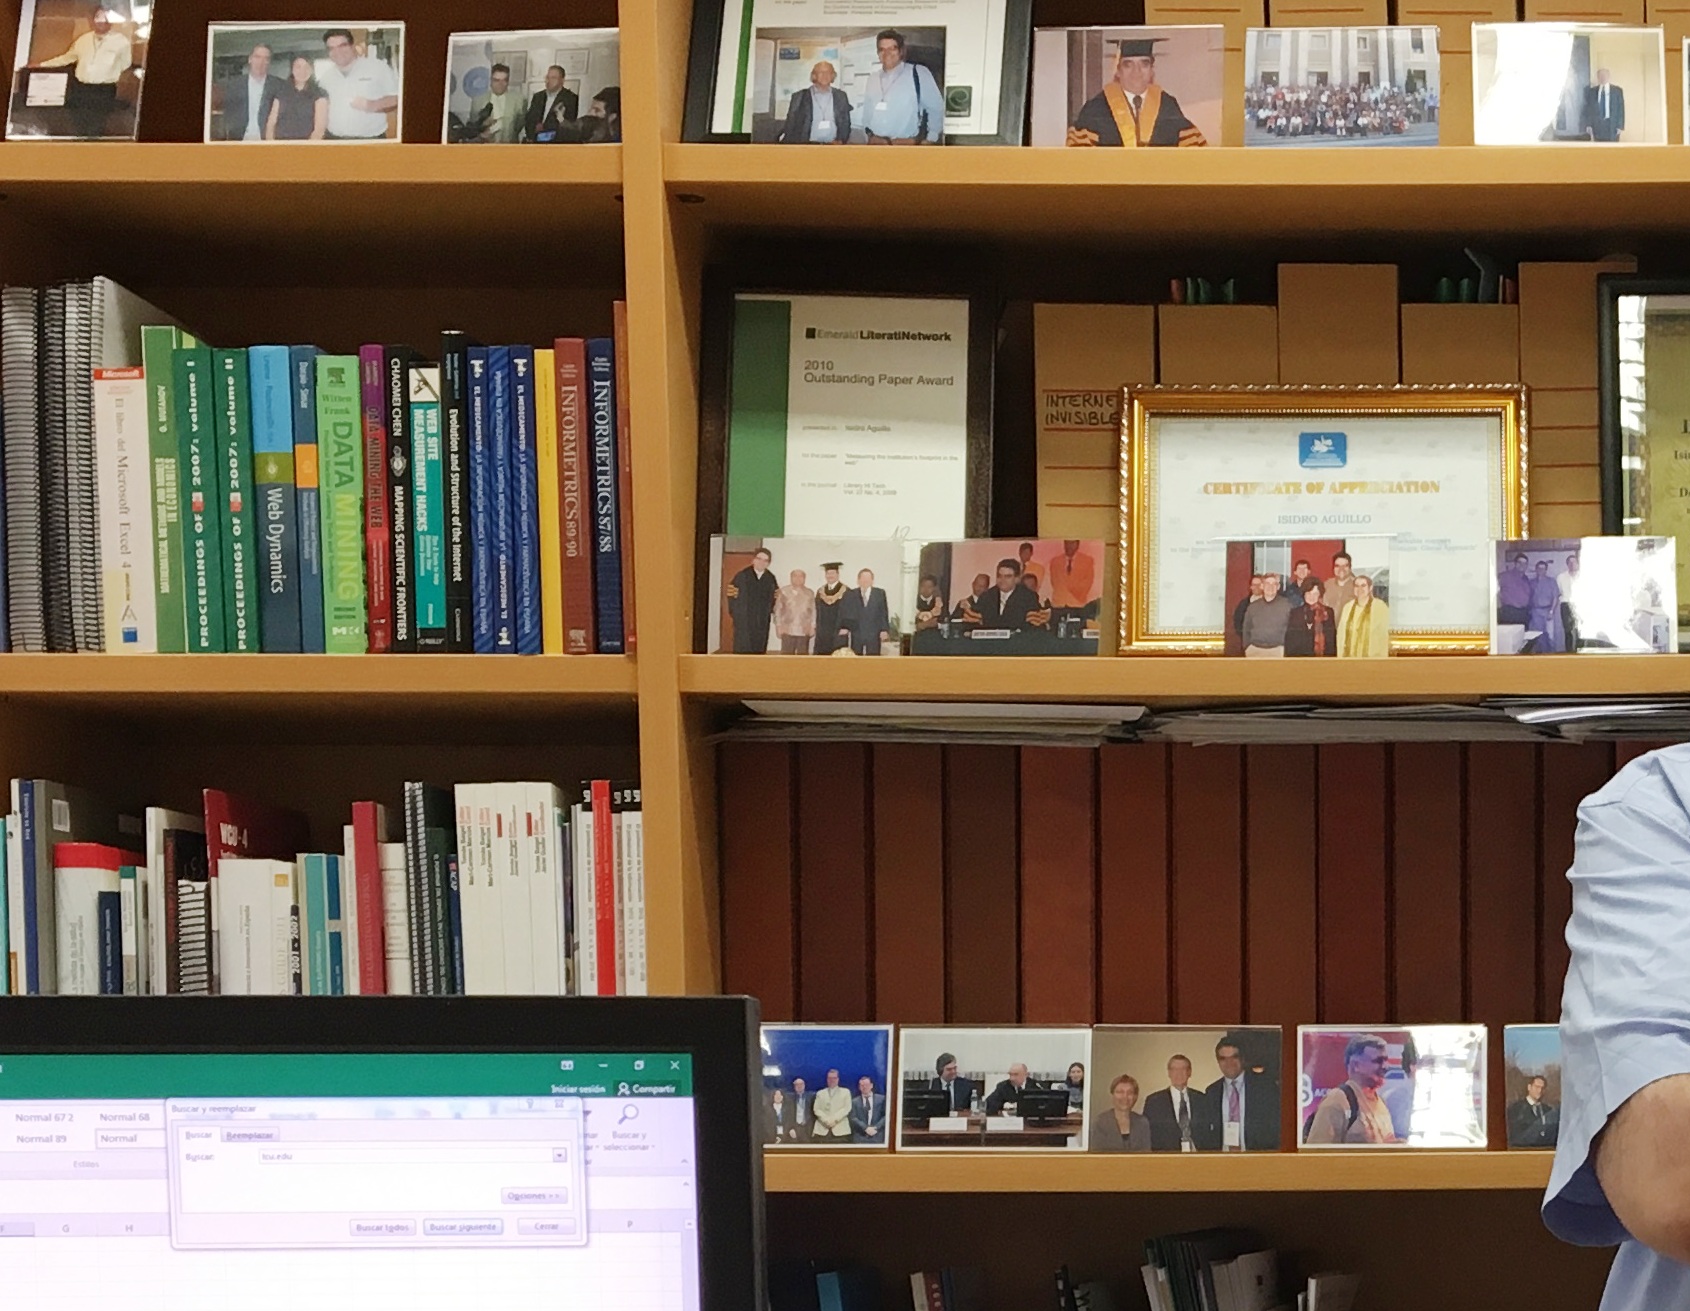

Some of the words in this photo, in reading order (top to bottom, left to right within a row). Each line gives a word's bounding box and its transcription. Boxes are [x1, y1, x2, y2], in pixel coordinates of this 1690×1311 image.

[102, 370, 140, 379] Microsoft
[224, 358, 234, 370] II
[804, 360, 834, 371] 2010
[390, 357, 402, 407] CHAOMEI
[804, 372, 875, 386] Outstanding
[878, 374, 914, 387] Paper
[916, 375, 954, 386] Award
[188, 372, 199, 432] volume
[226, 375, 237, 436] volume
[1045, 393, 1118, 408] INTERNE
[366, 406, 377, 432] DATA
[391, 408, 403, 437] CHEN
[426, 408, 438, 433] WEB
[1045, 409, 1120, 426] INVISIBLE
[449, 408, 460, 451] Evolution
[117, 438, 126, 453] del
[332, 421, 355, 488] DATA
[368, 436, 382, 478] MINING
[413, 408, 427, 492] MEASUREMENT
[427, 434, 439, 461] SITE
[561, 384, 579, 519] INFORMETRICS
[593, 379, 613, 515] INFORMETRICS
[190, 438, 202, 486] 2007:
[228, 441, 240, 489] 2007:
[450, 453, 460, 470] and
[117, 455, 131, 515] Microsoft
[165, 458, 177, 510] ECONOMICS
[370, 482, 382, 502] THE
[451, 472, 461, 514] Structure
[1202, 481, 1303, 495] CERTIFICATE
[1305, 481, 1325, 495] OF
[1328, 480, 1441, 494] APPRECIATION
[266, 487, 285, 521] Web
[393, 485, 406, 532] MAPPING
[416, 495, 428, 531] HACKS
[194, 513, 204, 533] OF
[232, 516, 242, 537] OF
[369, 505, 383, 528] WEB
[452, 516, 462, 526] of
[1277, 514, 1318, 525] ISIDRO
[1321, 514, 1372, 525] AGUILLO
[119, 522, 132, 555] Excel
[452, 527, 462, 542] the
[565, 520, 578, 557] 89/90
[598, 515, 613, 553] 87/88
[265, 523, 287, 594] Dynamics
[335, 493, 361, 603] MINING
[394, 532, 407, 586] SCIENTIFIC
[453, 544, 463, 582] Internet
[195, 539, 209, 647] PROCEEDINGS
[233, 542, 247, 650] PROCEEDINGS
[396, 586, 408, 641] FRONTIERS
[290, 915, 299, 940] 2002
[291, 951, 300, 974] 2001
[550, 1083, 577, 1095] Iniciar
[579, 1083, 606, 1095] sesión
[632, 1083, 677, 1096] Compartir
[15, 1113, 52, 1122] Normal
[54, 1113, 66, 1122] 67
[99, 1112, 137, 1122] Normal
[138, 1112, 151, 1122] 68
[171, 1104, 199, 1113] Buscar
[208, 1103, 257, 1114] reemplazar
[16, 1134, 53, 1143] Normal
[55, 1134, 67, 1143] 89
[100, 1133, 137, 1143] Normal
[185, 1130, 213, 1140] Buscar
[225, 1130, 274, 1140] Reemplazar
[611, 1130, 638, 1140] Buscar
[603, 1142, 650, 1152] seleccionar
[73, 1159, 100, 1169] Estilos
[507, 1190, 546, 1202] Opciones
[356, 1222, 382, 1232] Buscar
[385, 1222, 409, 1233] todos
[429, 1222, 457, 1232] Buscar
[459, 1221, 497, 1234] siguiente
[534, 1221, 560, 1231] Cerrar
